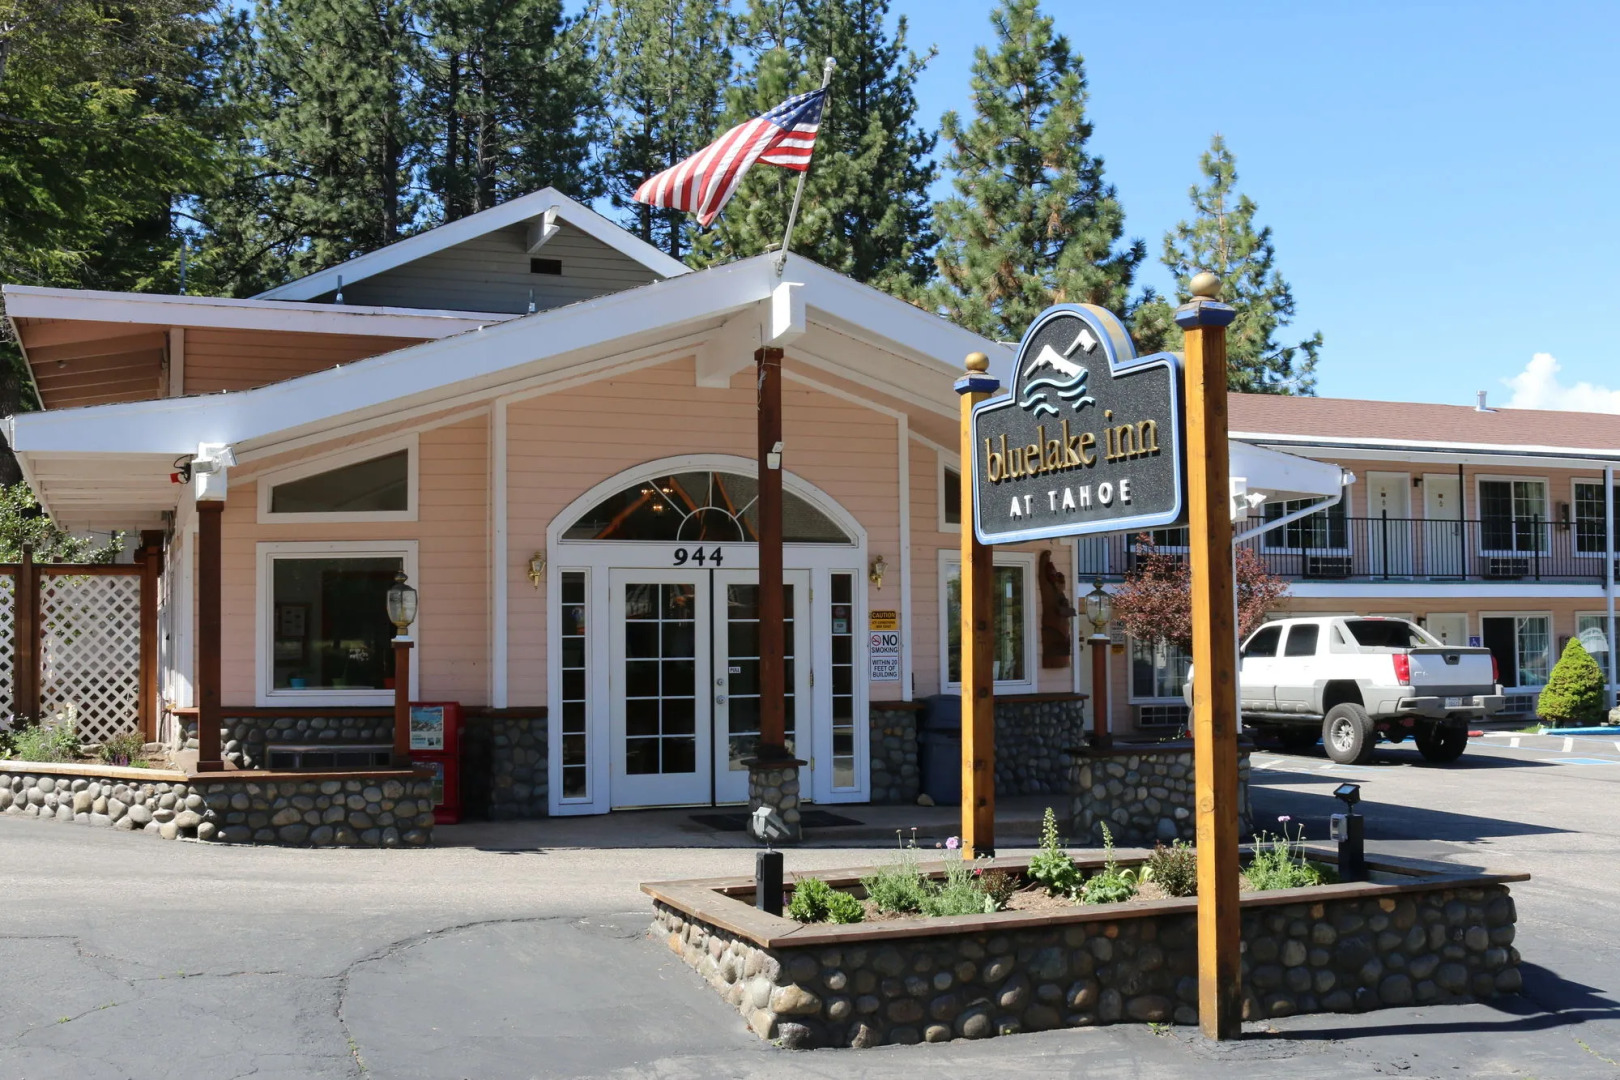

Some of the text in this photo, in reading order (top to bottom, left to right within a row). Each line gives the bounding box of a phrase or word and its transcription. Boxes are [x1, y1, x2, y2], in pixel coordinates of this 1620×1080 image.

[984, 409, 1161, 482] bluelake inn
[1010, 479, 1132, 517] AT TAHOE
[673, 546, 723, 567] 944
[882, 634, 898, 646] NO
